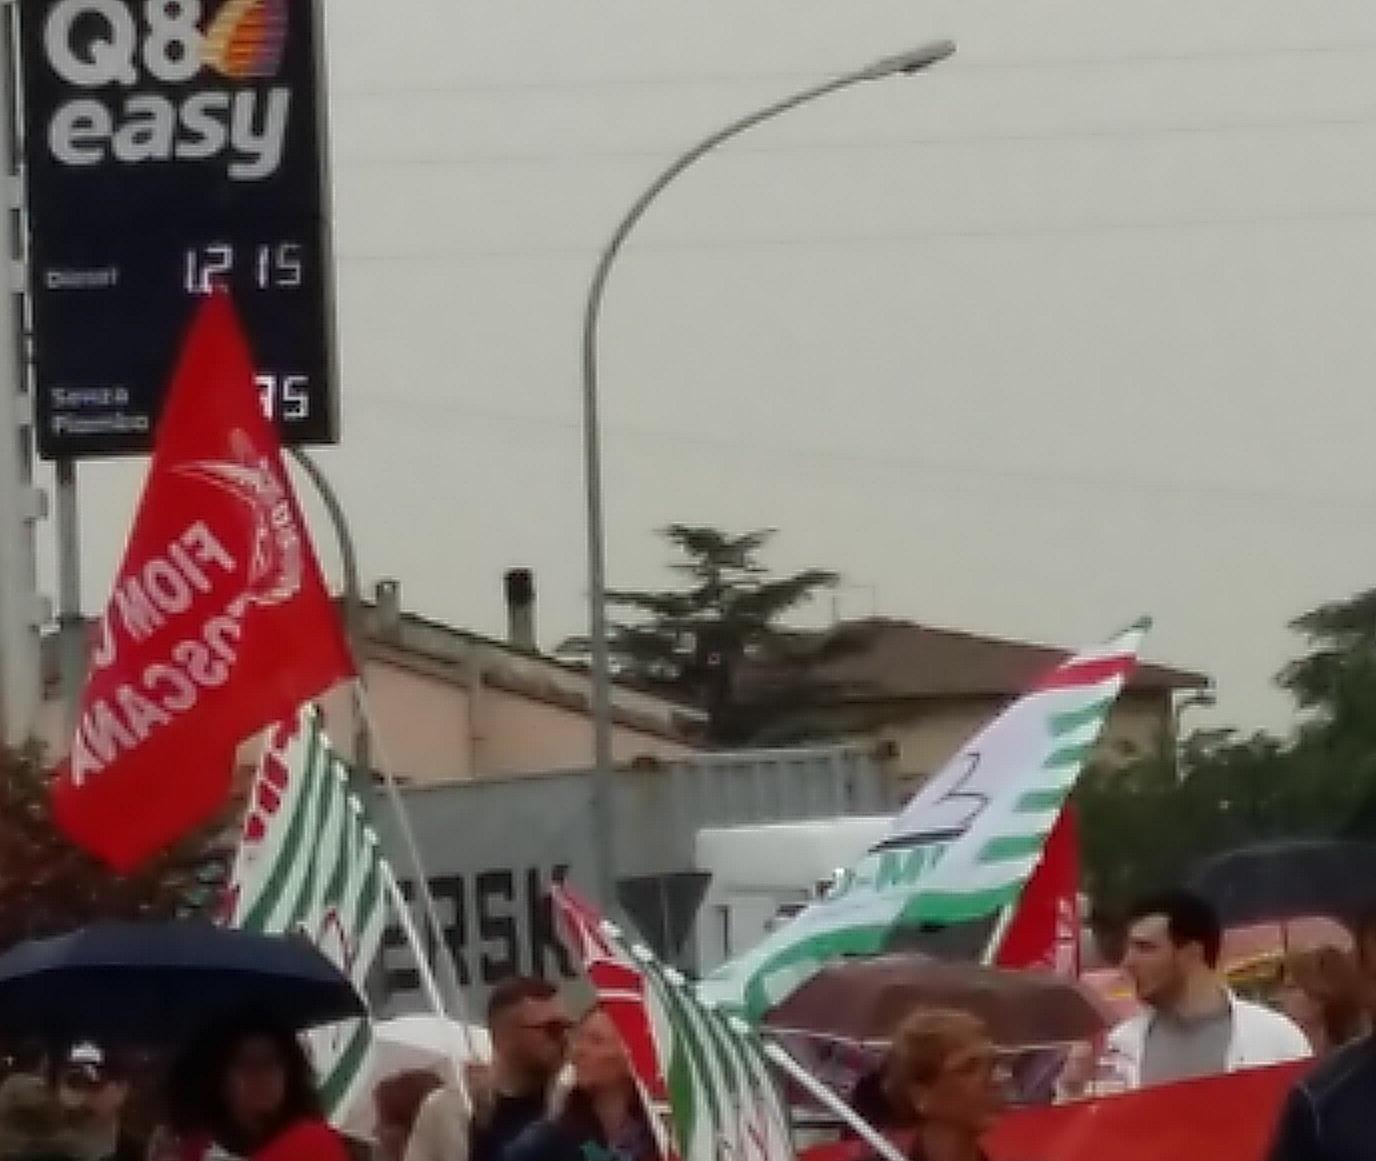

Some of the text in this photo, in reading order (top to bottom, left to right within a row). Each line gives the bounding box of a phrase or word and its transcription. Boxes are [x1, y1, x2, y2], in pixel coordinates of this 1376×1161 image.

[44, 0, 204, 85] Q8
[49, 86, 290, 181] easy
[377, 864, 579, 990] ERSK
